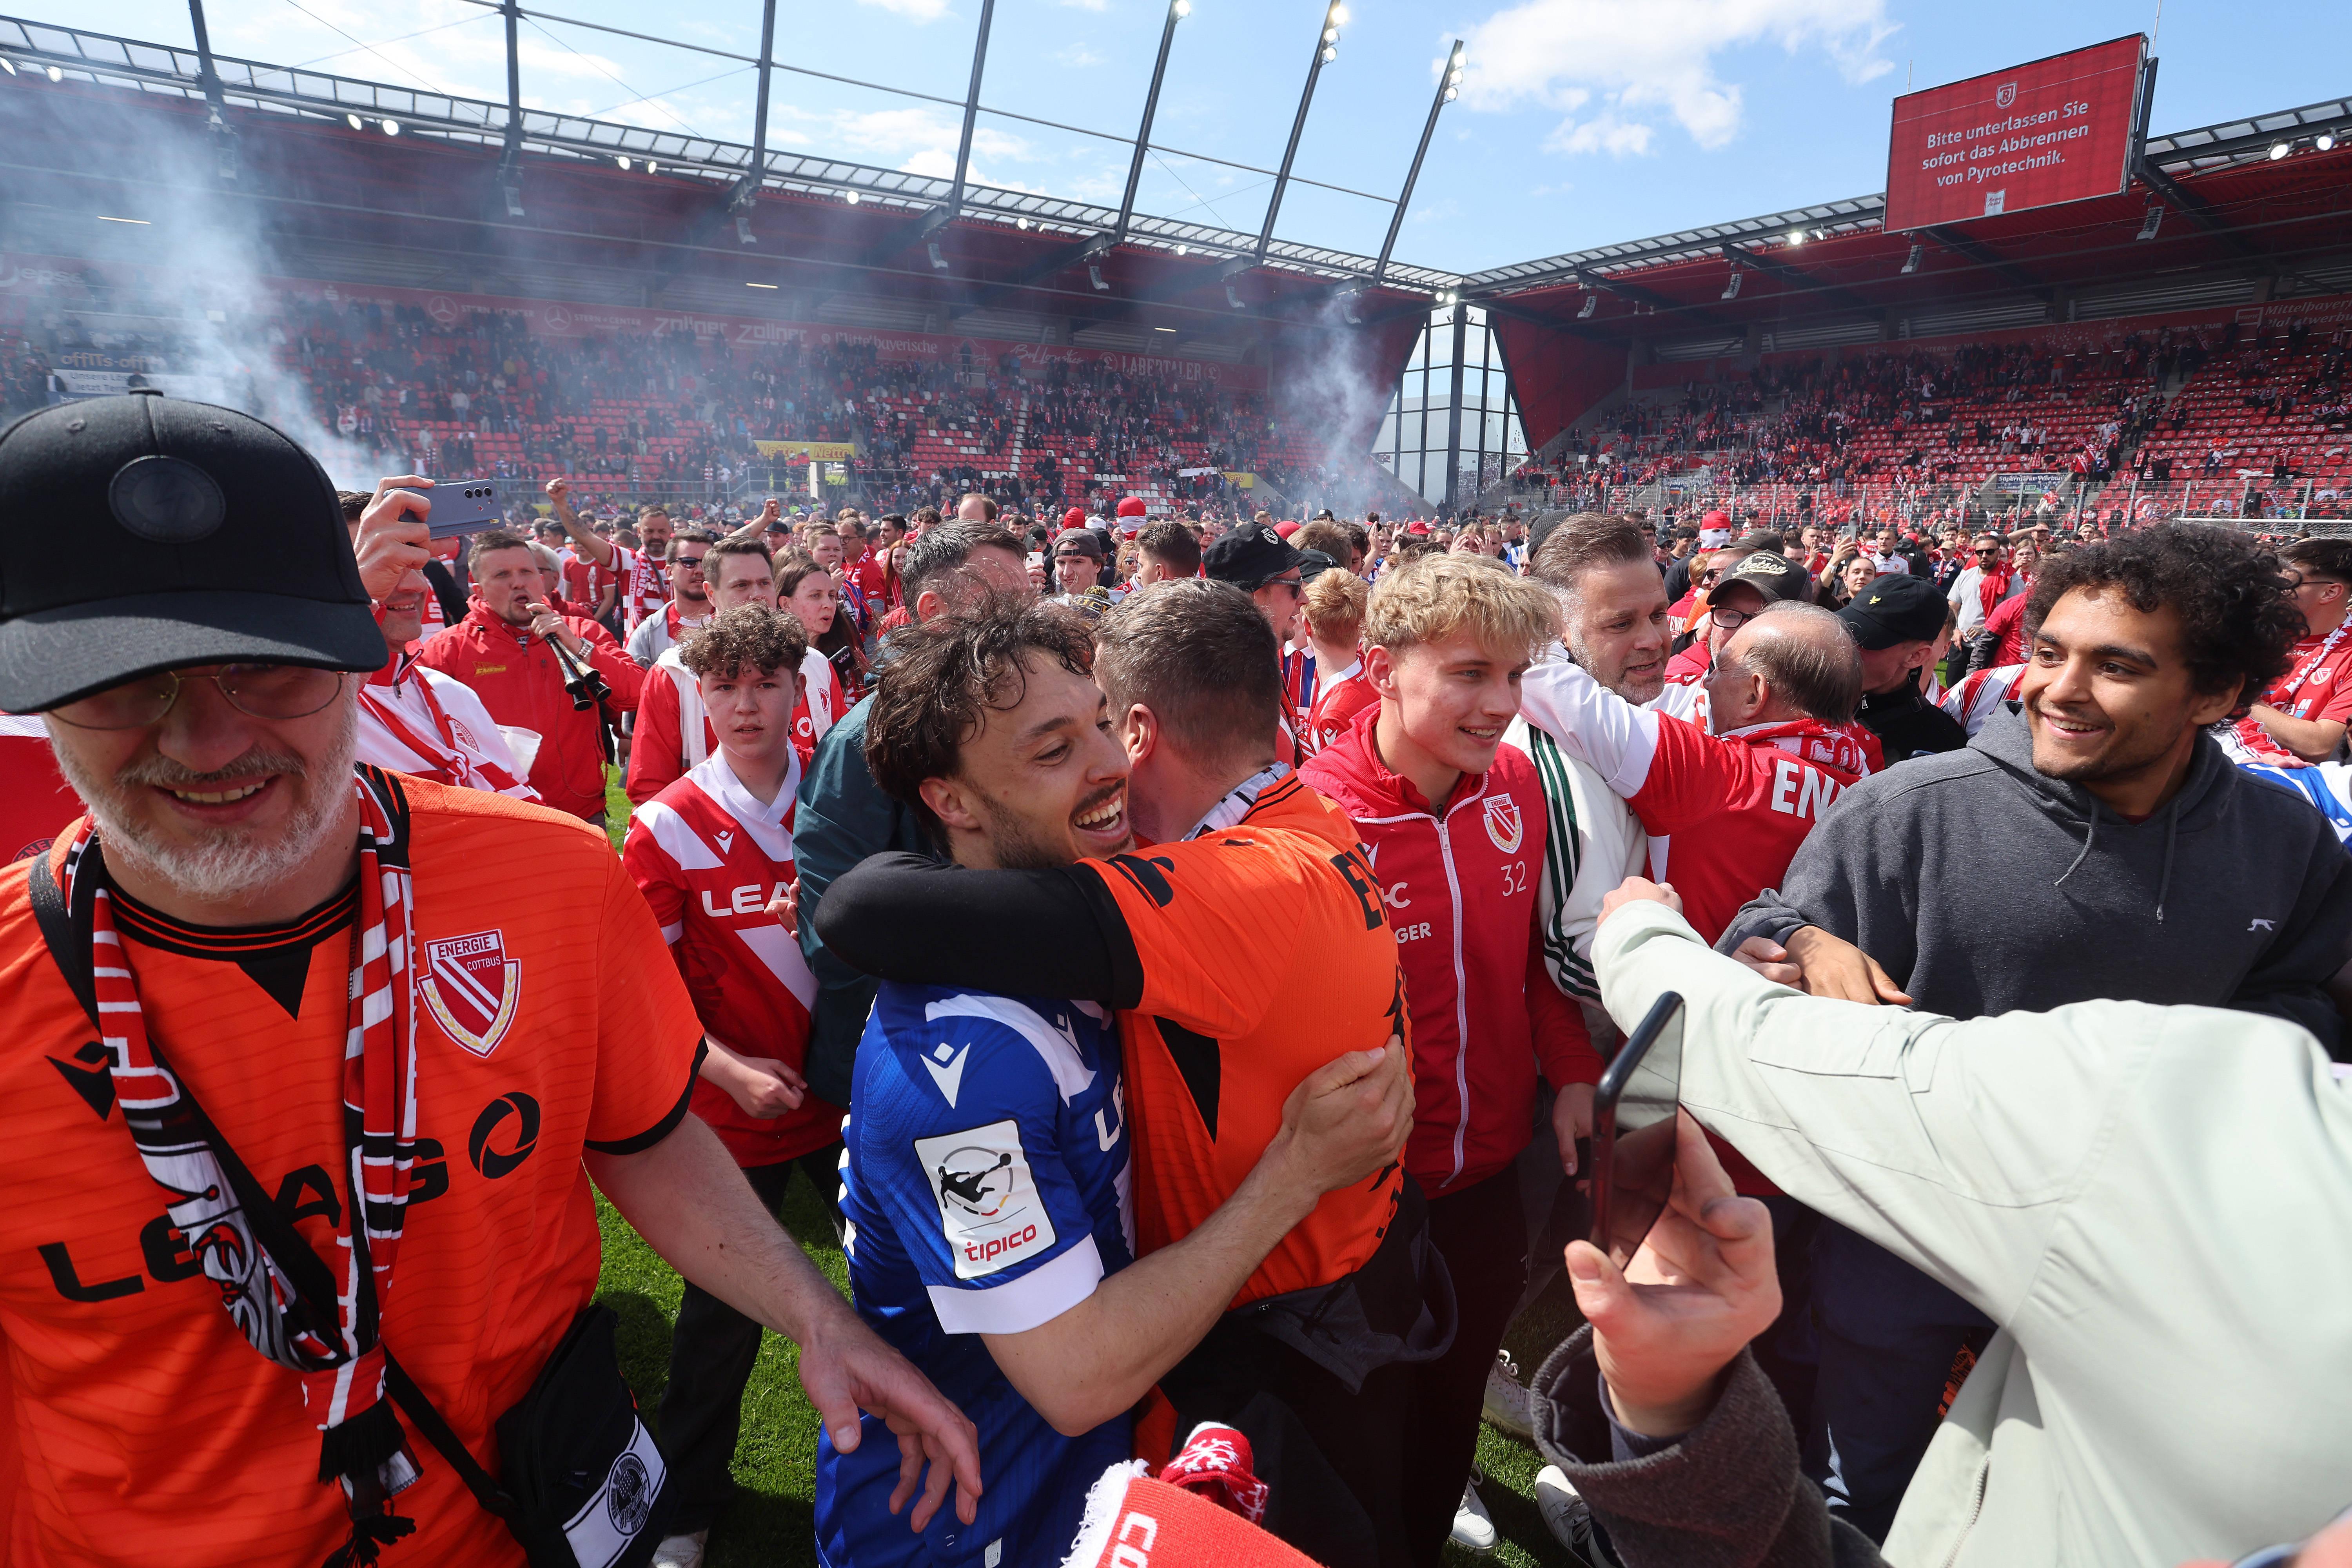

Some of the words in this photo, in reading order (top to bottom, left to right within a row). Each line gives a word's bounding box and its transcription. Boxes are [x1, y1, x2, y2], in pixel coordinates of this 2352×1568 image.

[1927, 130, 1962, 149] Bitte
[1966, 110, 2057, 140] unterlassen
[2062, 100, 2089, 119] Sie
[1922, 150, 1965, 170] sofort
[1969, 144, 1995, 160] das
[1998, 123, 2089, 154] Abbrennen
[1937, 172, 1964, 187] von
[1967, 149, 2065, 184] Pyrotechnik.
[814, 445, 849, 459] Netto
[1734, 557, 1788, 575] Stetson
[1491, 799, 1508, 807] ENERGIE
[1771, 759, 1846, 822] EN
[1500, 860, 1527, 897] 32
[701, 881, 790, 917] LEA
[437, 936, 491, 958] ENERGIE
[1394, 922, 1432, 944] GER
[467, 956, 501, 971] COTTBUS
[964, 1223, 1037, 1262] tipico
